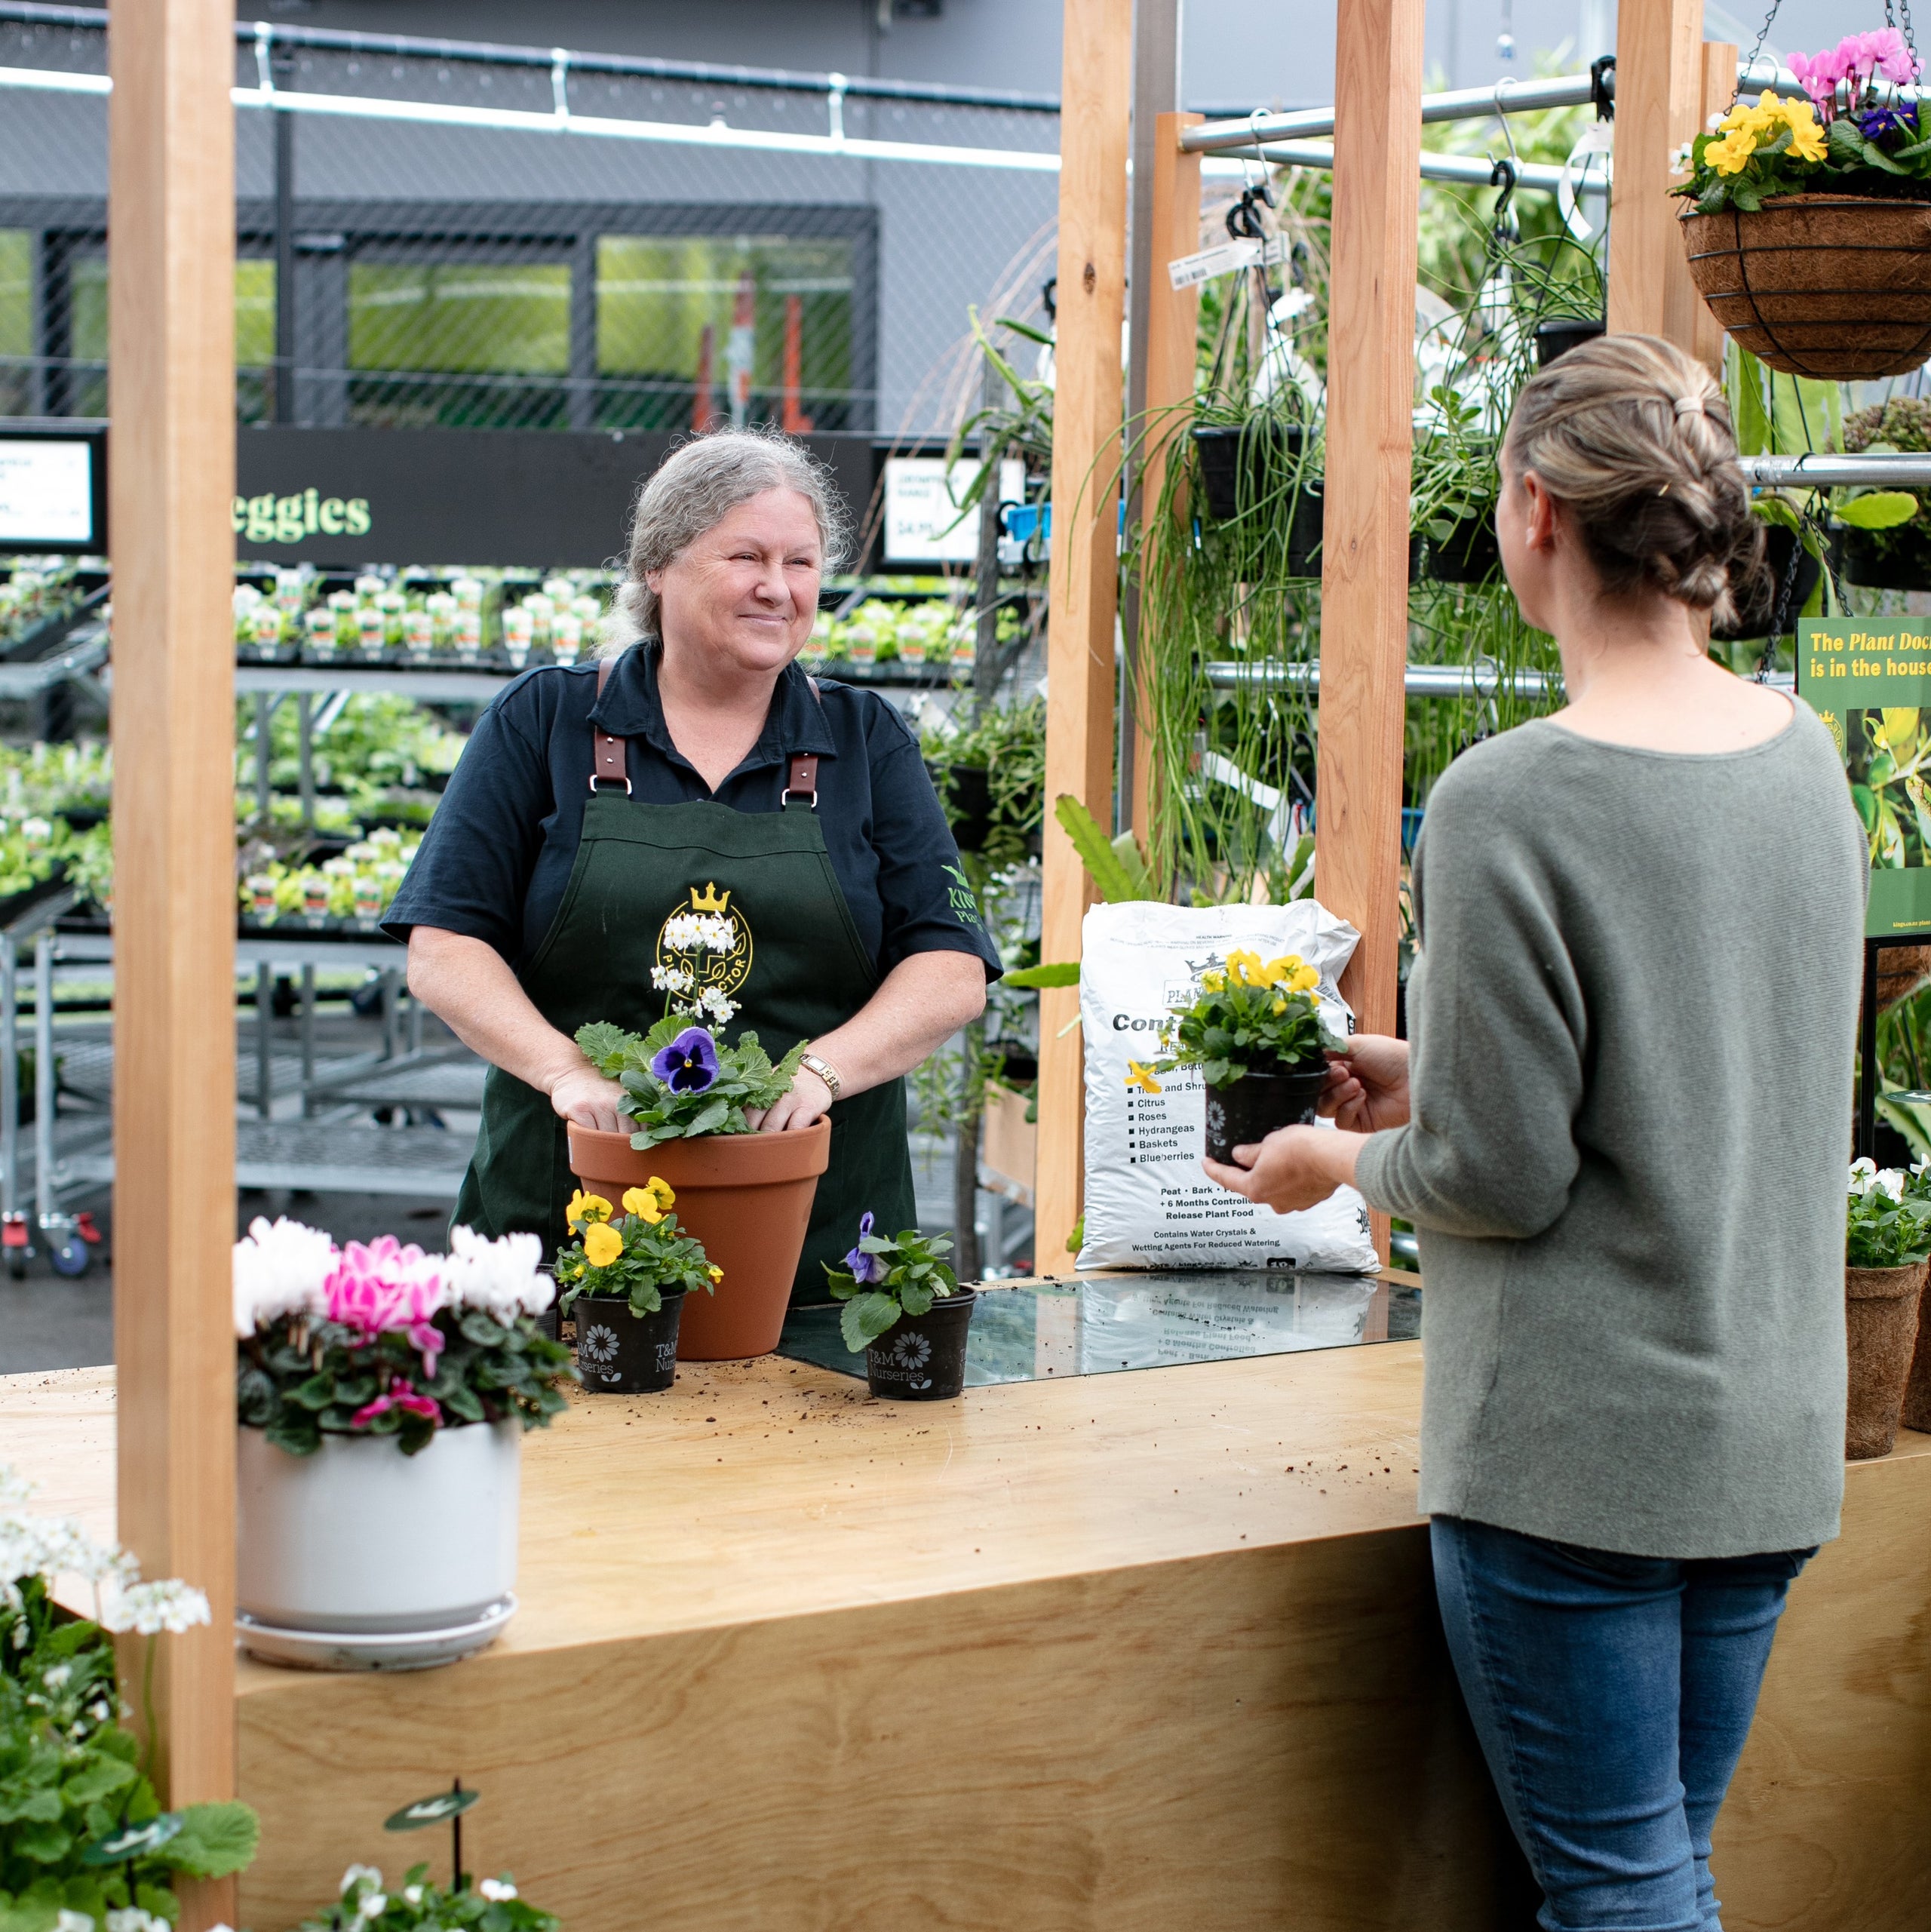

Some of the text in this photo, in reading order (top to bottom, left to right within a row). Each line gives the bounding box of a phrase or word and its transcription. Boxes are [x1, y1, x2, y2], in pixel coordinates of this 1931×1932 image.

[1810, 632, 1931, 652] The Plant Doc
[1810, 658, 1825, 677] is
[1830, 658, 1847, 677] in
[1851, 658, 1882, 677] the
[698, 959, 746, 997] DCTOR
[1165, 1083, 1182, 1092] and
[1137, 1099, 1165, 1107] Citrus
[1138, 1113, 1167, 1122] Roses
[1139, 1125, 1195, 1136] Hydrangeas
[1139, 1139, 1177, 1149] Baskets
[1140, 1152, 1195, 1163] Blueberries
[1161, 1187, 1181, 1196] Peat
[1175, 1199, 1209, 1207] Months
[1166, 1209, 1254, 1220] Release Plant Food
[1153, 1230, 1188, 1239] Contains
[1190, 1229, 1214, 1237] Water
[1215, 1228, 1248, 1238] Crystals
[1132, 1243, 1163, 1252] Wetting
[1164, 1242, 1192, 1252] Agents
[1208, 1240, 1242, 1249] Reduced
[1244, 1239, 1281, 1248] Watering
[868, 1348, 895, 1366] T&M
[869, 1362, 924, 1381] Nurseries
